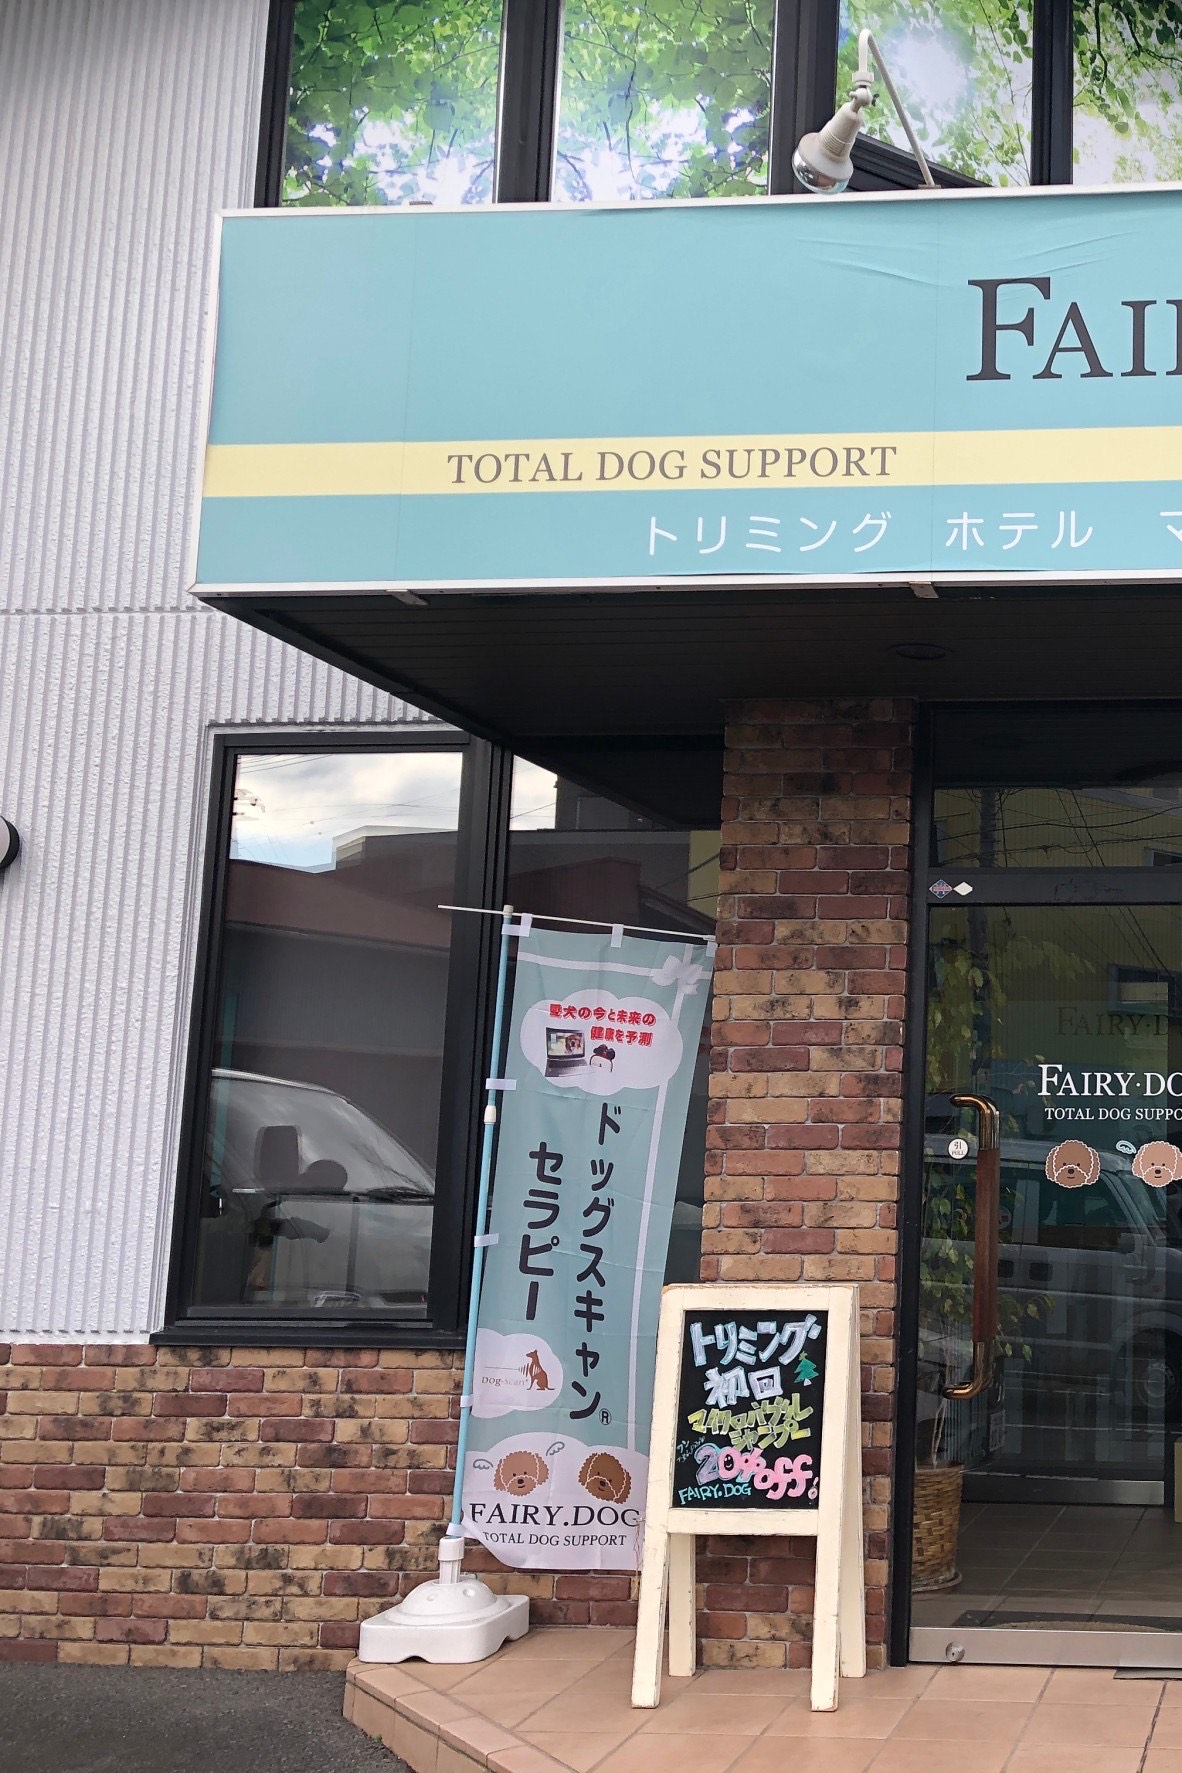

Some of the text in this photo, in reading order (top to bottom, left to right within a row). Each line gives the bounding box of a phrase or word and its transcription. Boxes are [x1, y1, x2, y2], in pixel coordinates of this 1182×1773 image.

[447, 445, 897, 484] TOTAL DOG SUPPORT
[648, 510, 892, 556] トリミング
[945, 509, 1093, 551] ホテル
[549, 1003, 657, 1027] 愛犬の今と未来の
[590, 1026, 654, 1047] 健康を予測
[1044, 1107, 1095, 1120] TOTAL
[1098, 1108, 1132, 1120] DOG
[953, 1141, 962, 1150] 引
[518, 1141, 564, 1321] セラピー
[689, 1313, 822, 1367] トリミング
[703, 1365, 784, 1409] 初回
[482, 1531, 627, 1547] TOTAL DOG SUPPORT
